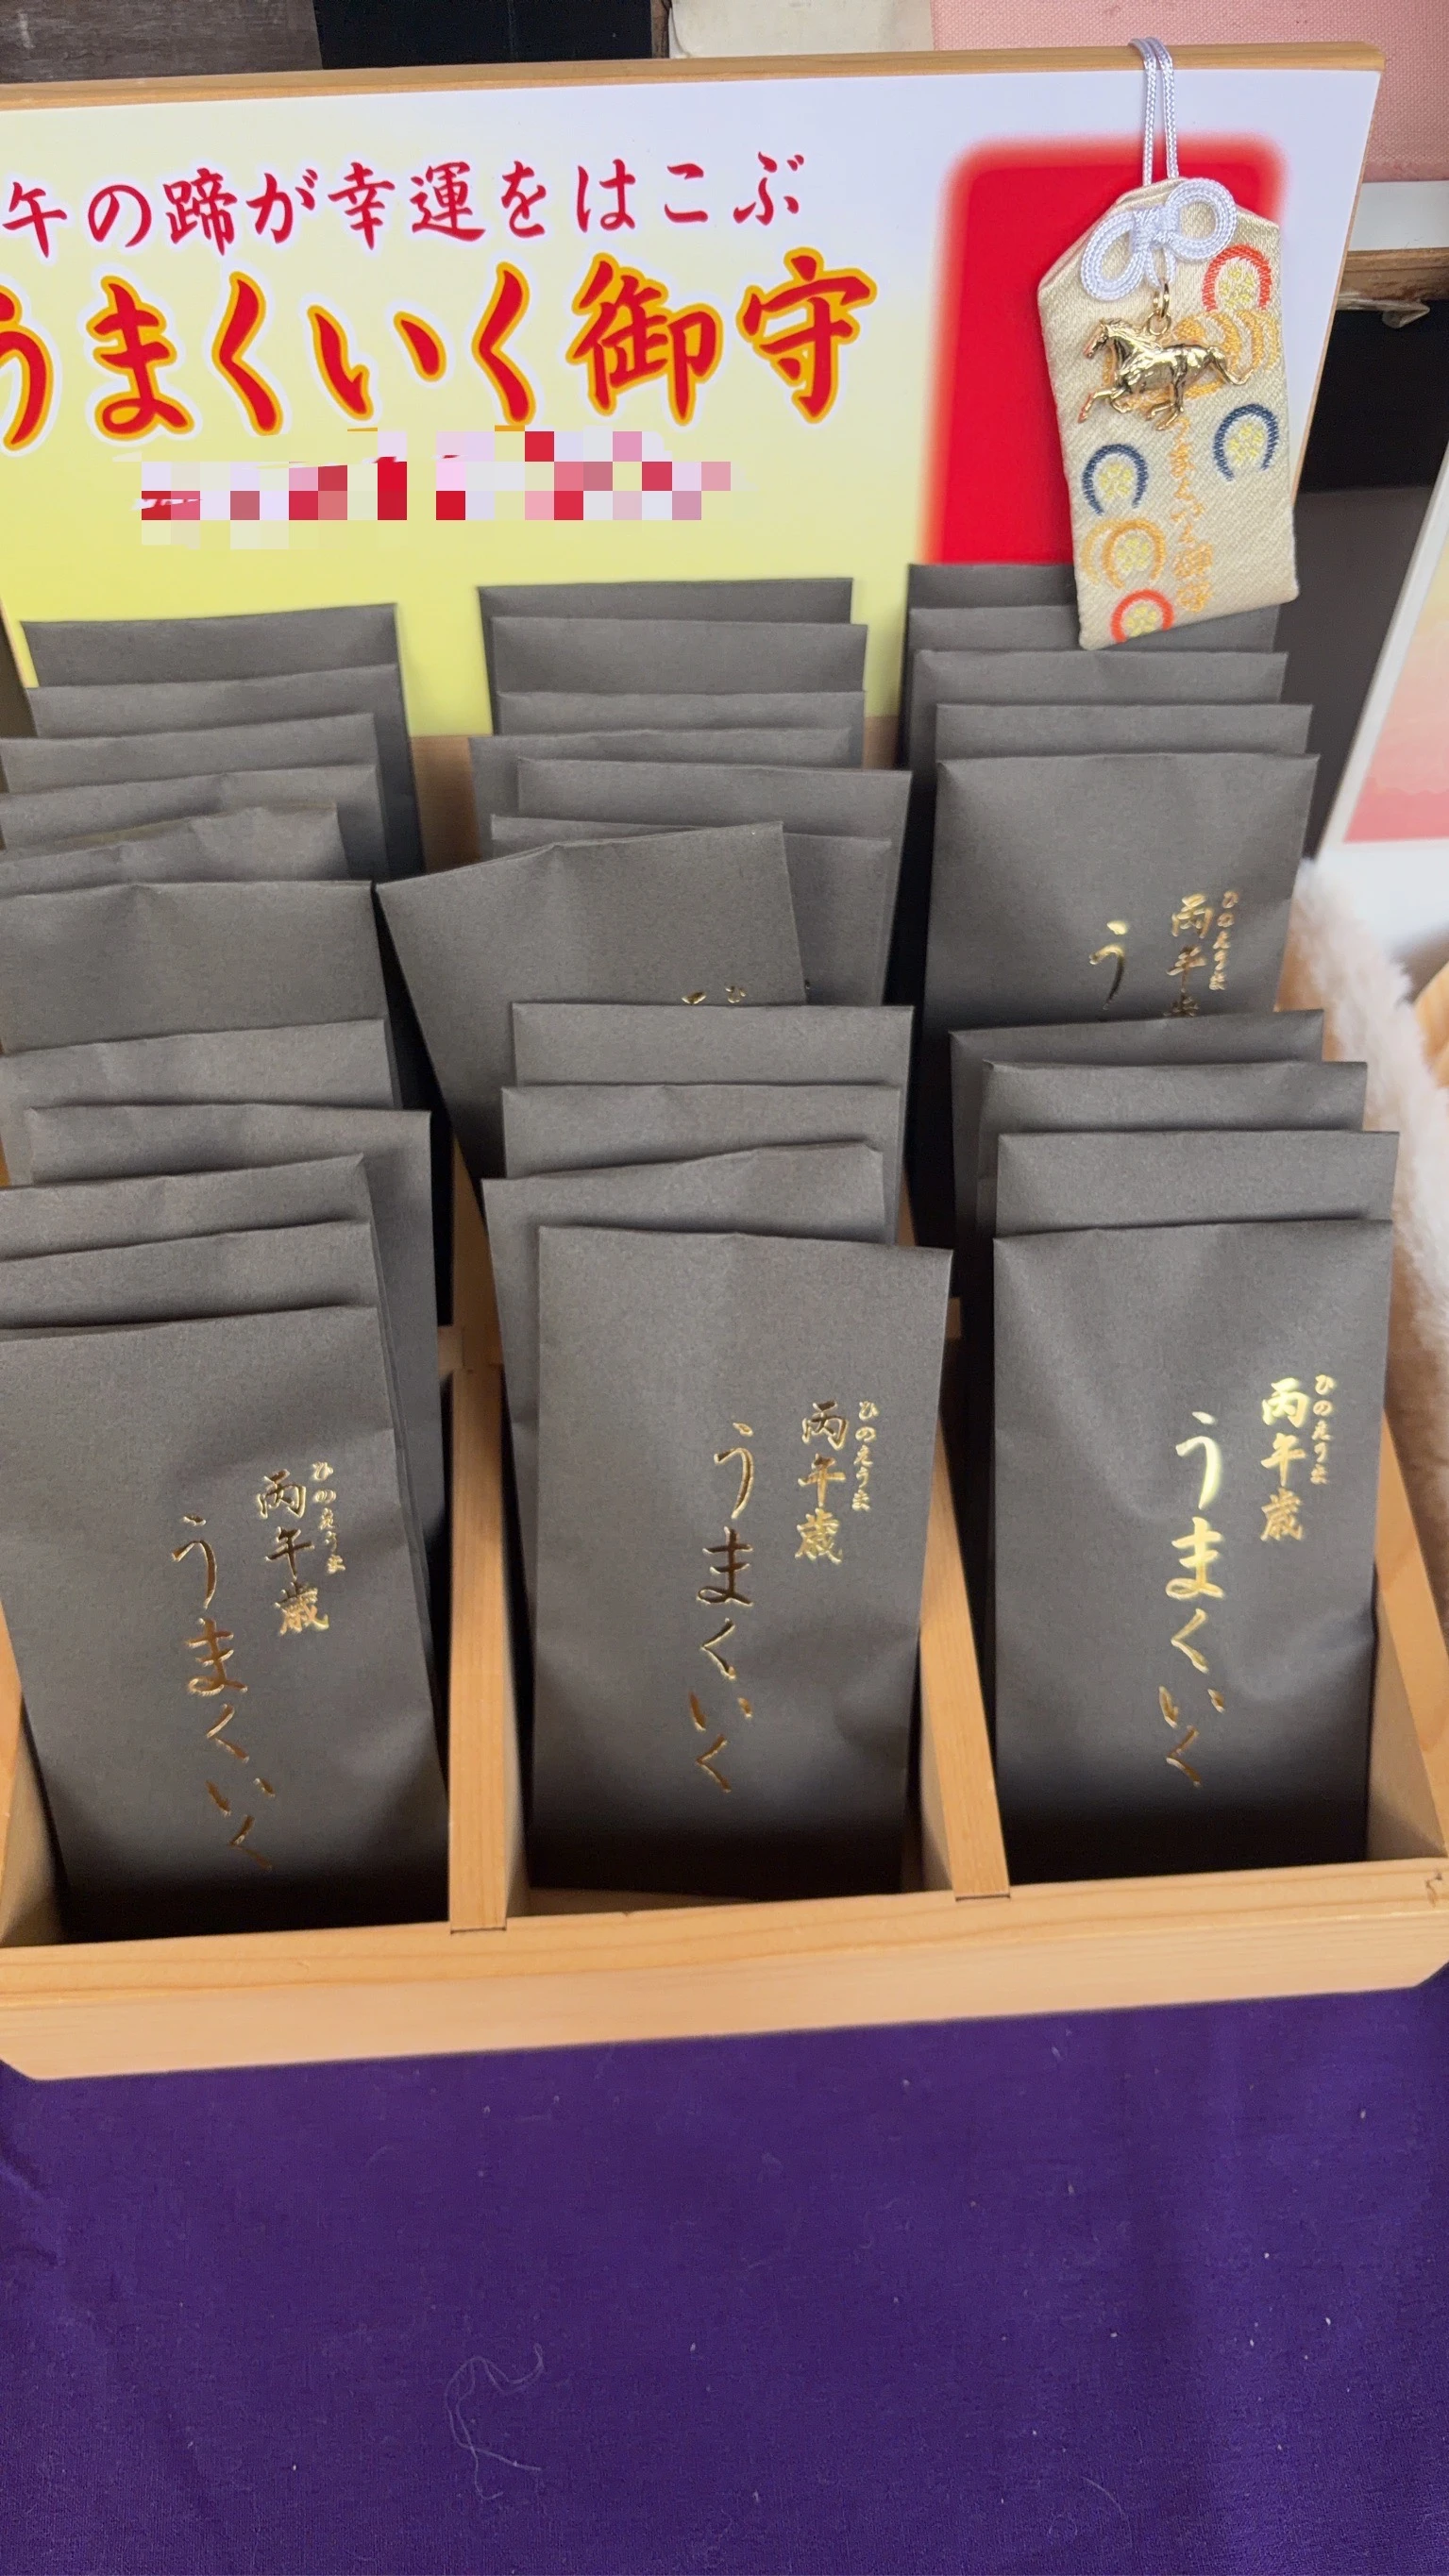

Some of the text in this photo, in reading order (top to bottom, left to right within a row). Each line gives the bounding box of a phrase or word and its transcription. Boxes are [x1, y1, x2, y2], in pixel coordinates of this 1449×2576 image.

[2, 151, 807, 258] 午の蹄が幸運をはこぶ
[0, 246, 877, 450] うまくいく御守
[1088, 919, 1129, 1011] う
[795, 1400, 848, 1564] 丙午歳
[851, 1401, 879, 1511] ひのえうま
[1260, 1377, 1310, 1541] 丙午歳
[1310, 1373, 1337, 1485] ひのえうま
[257, 1468, 329, 1635] 丙午歳
[311, 1460, 346, 1575] ひのえうま
[1157, 1410, 1225, 1788] うまくいく
[687, 1422, 753, 1793] うまくいく
[171, 1514, 275, 1872] うまくいく
